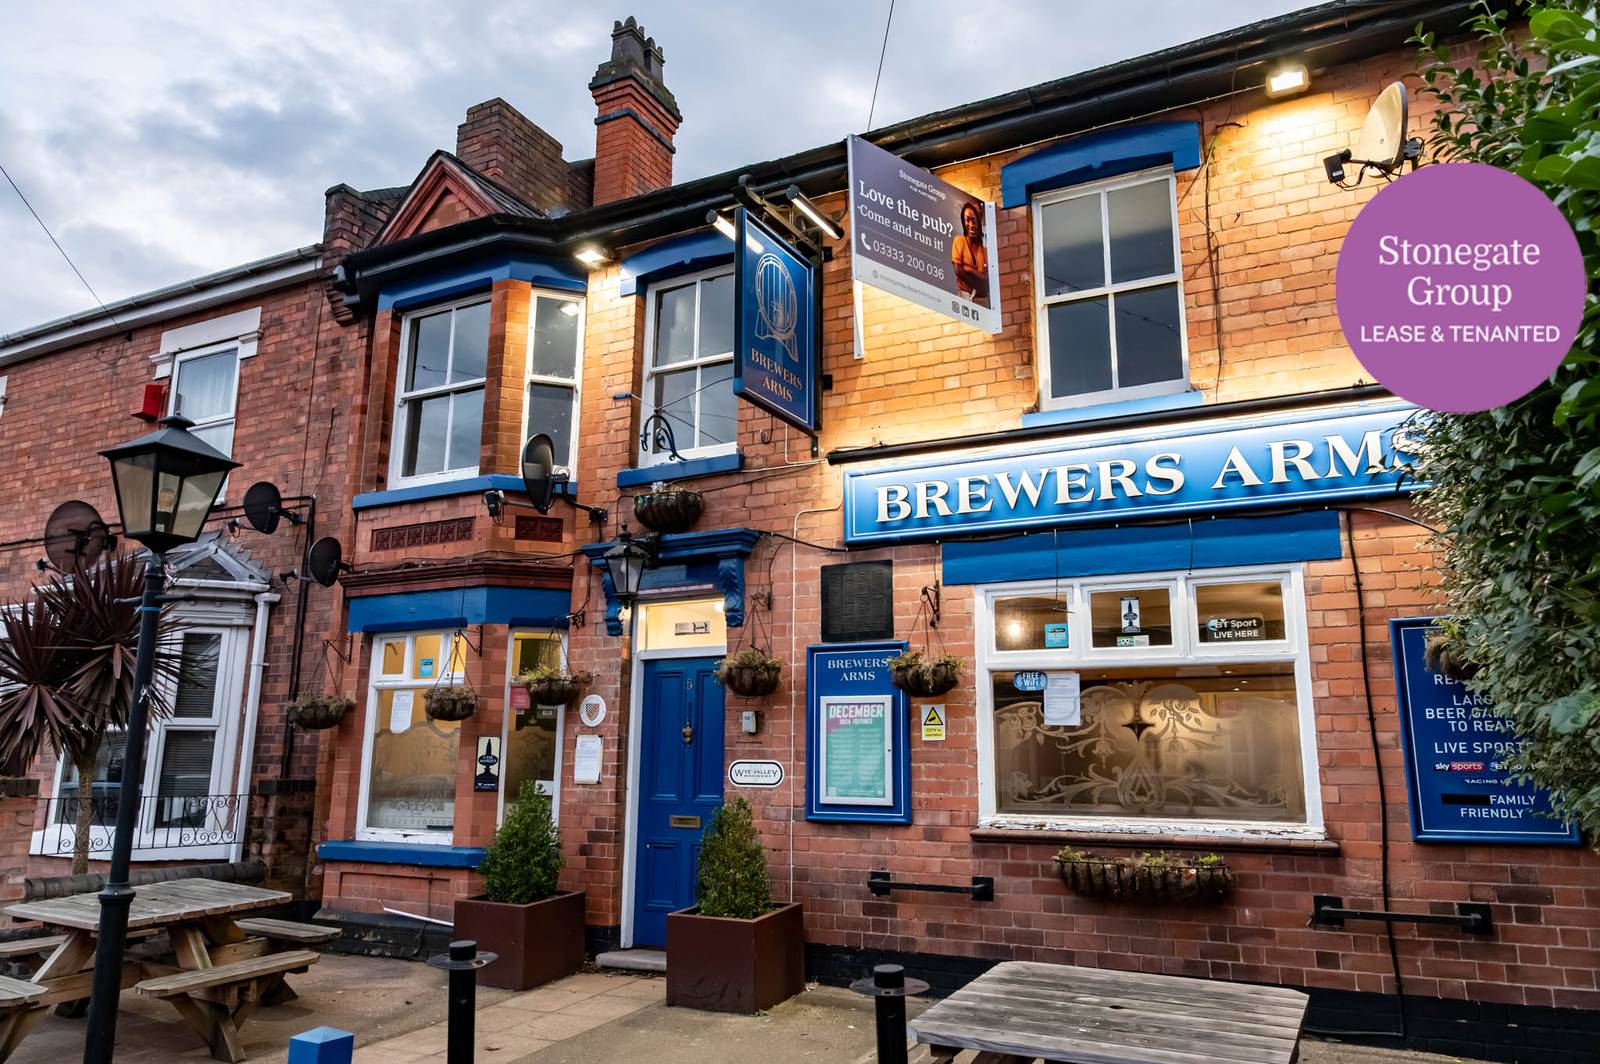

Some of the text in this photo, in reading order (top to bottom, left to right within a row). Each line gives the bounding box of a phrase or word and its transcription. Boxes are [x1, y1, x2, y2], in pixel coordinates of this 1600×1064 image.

[899, 169, 947, 200] Stonegate Group
[859, 180, 954, 238] Love the pub?
[860, 204, 944, 252] Come and run it!
[872, 240, 945, 280] 03333 200 036
[751, 347, 803, 390] BREWERS
[762, 375, 793, 402] ARMS
[875, 452, 1185, 523] BREWERS
[1214, 619, 1257, 628] BT Sport
[1213, 629, 1260, 639] LIVE HERE
[827, 658, 889, 669] BREWERS
[840, 671, 876, 681] ARMS
[1022, 672, 1040, 680] FREE
[1453, 694, 1495, 706] LARG
[829, 704, 884, 719] DECEMBER
[1425, 707, 1467, 719] BEER
[1448, 720, 1516, 732] TO REAR
[1434, 741, 1469, 754] LIVE
[1435, 762, 1483, 771] sky sports
[753, 769, 778, 777] VALLEY
[1489, 794, 1536, 806] FAMILY
[1460, 807, 1524, 819] FRIENDLY
